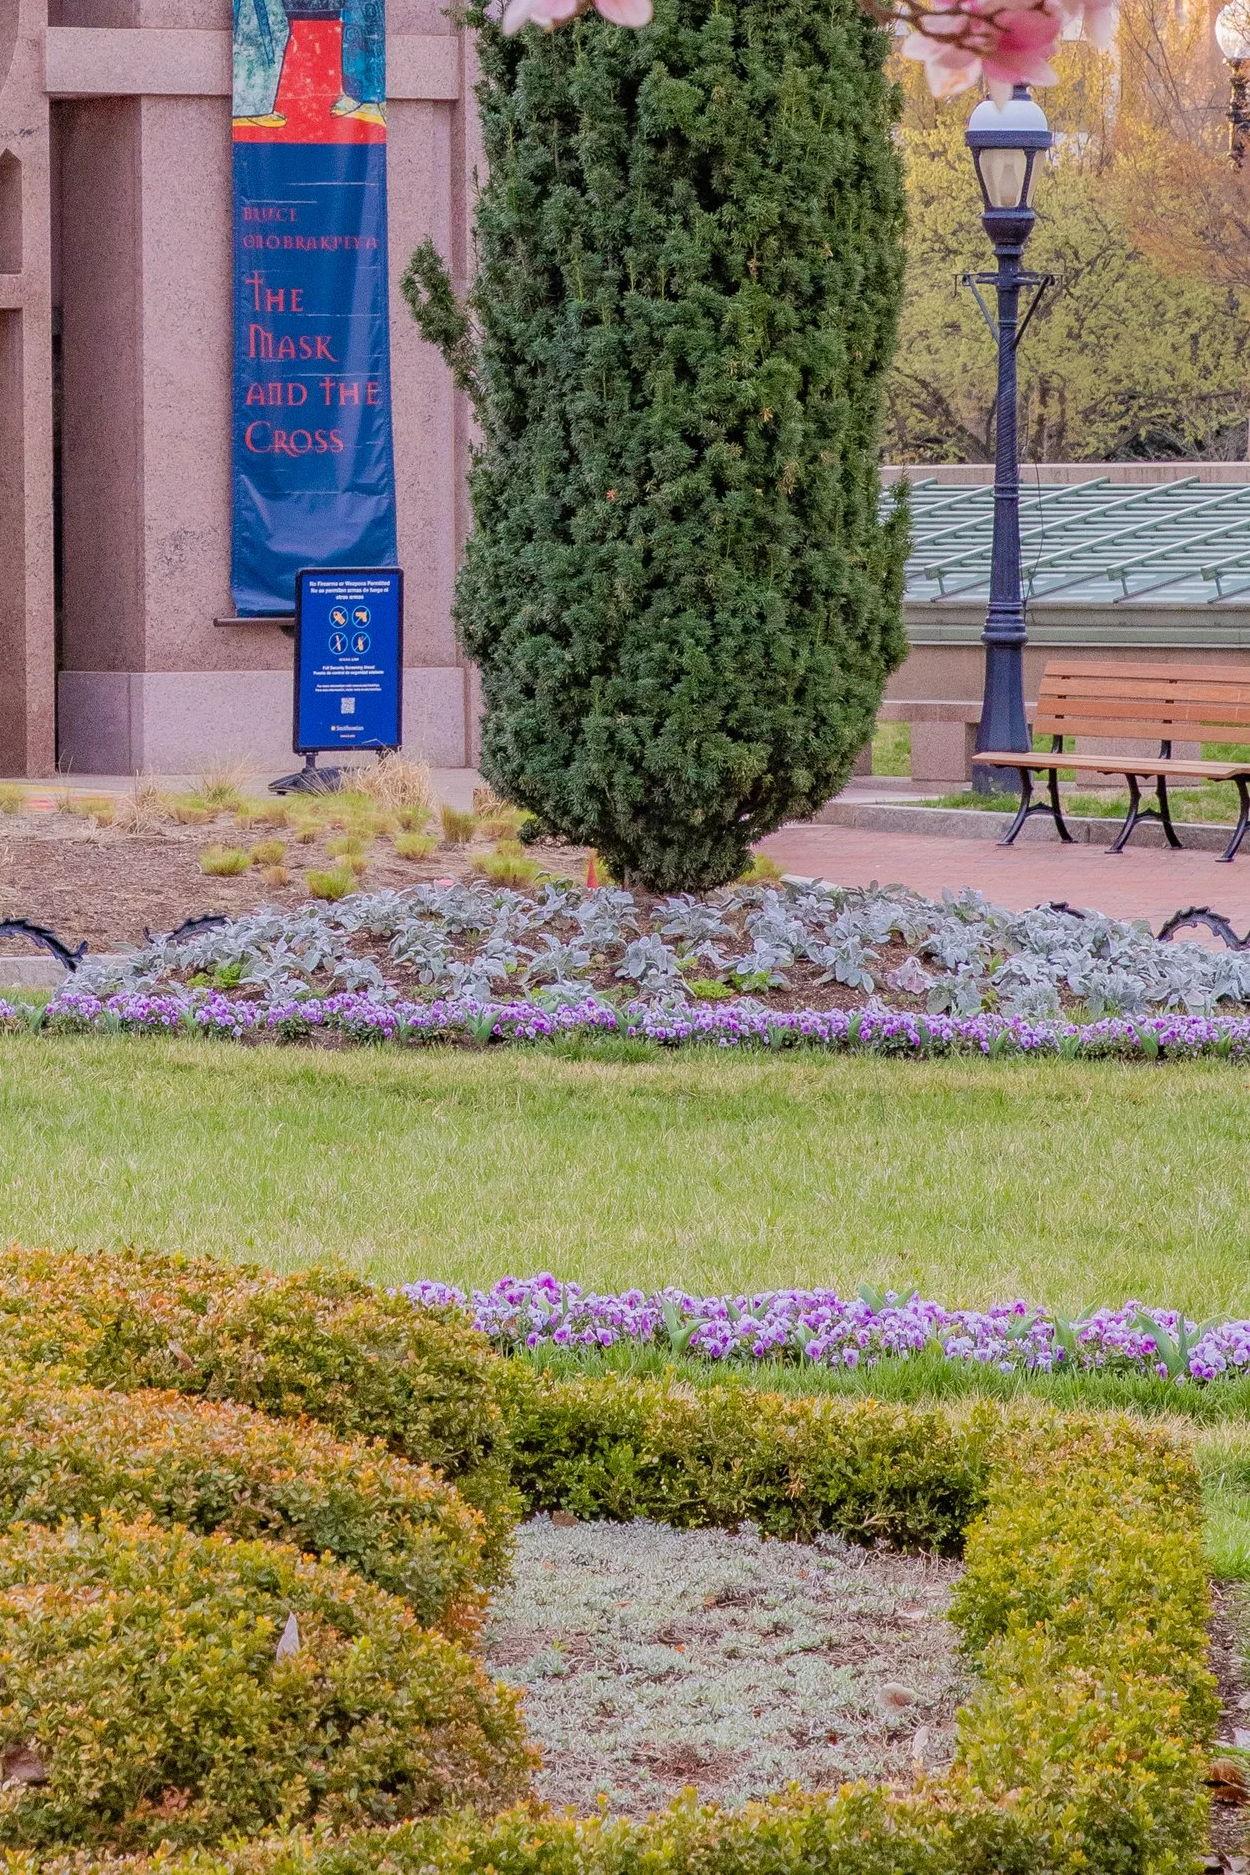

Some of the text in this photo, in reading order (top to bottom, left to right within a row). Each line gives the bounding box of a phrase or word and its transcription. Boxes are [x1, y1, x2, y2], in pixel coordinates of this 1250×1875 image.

[243, 206, 297, 223] BRUCE
[245, 270, 304, 313] THE
[250, 323, 338, 363] MASK
[245, 376, 382, 407] AND THE
[244, 420, 345, 458] CROSS
